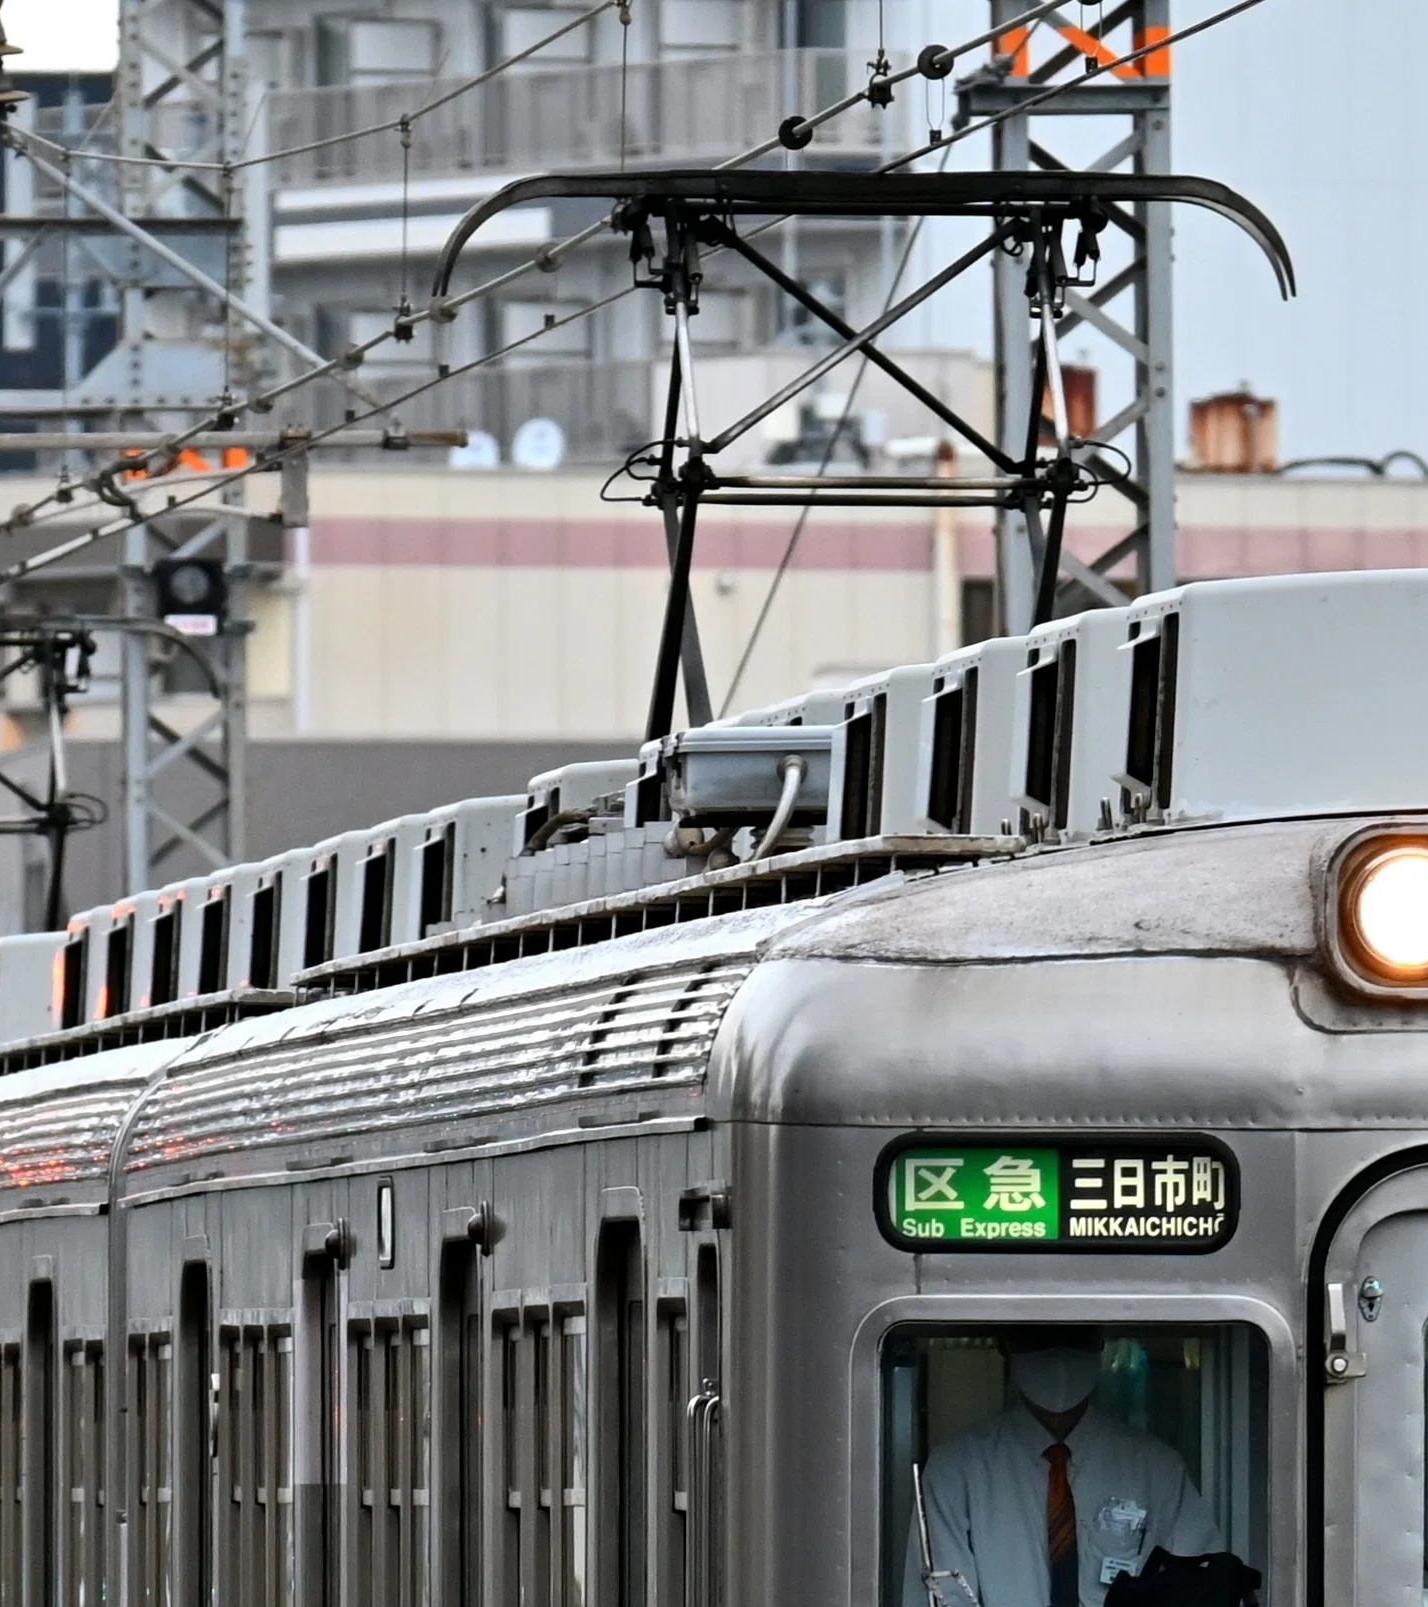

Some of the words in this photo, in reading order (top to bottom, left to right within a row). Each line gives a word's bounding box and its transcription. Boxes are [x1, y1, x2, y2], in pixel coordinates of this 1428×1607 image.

[904, 1154, 1046, 1211] 区急
[1069, 1155, 1225, 1212] 三日市町
[901, 1217, 945, 1238] Sub
[960, 1217, 1047, 1239] Express
